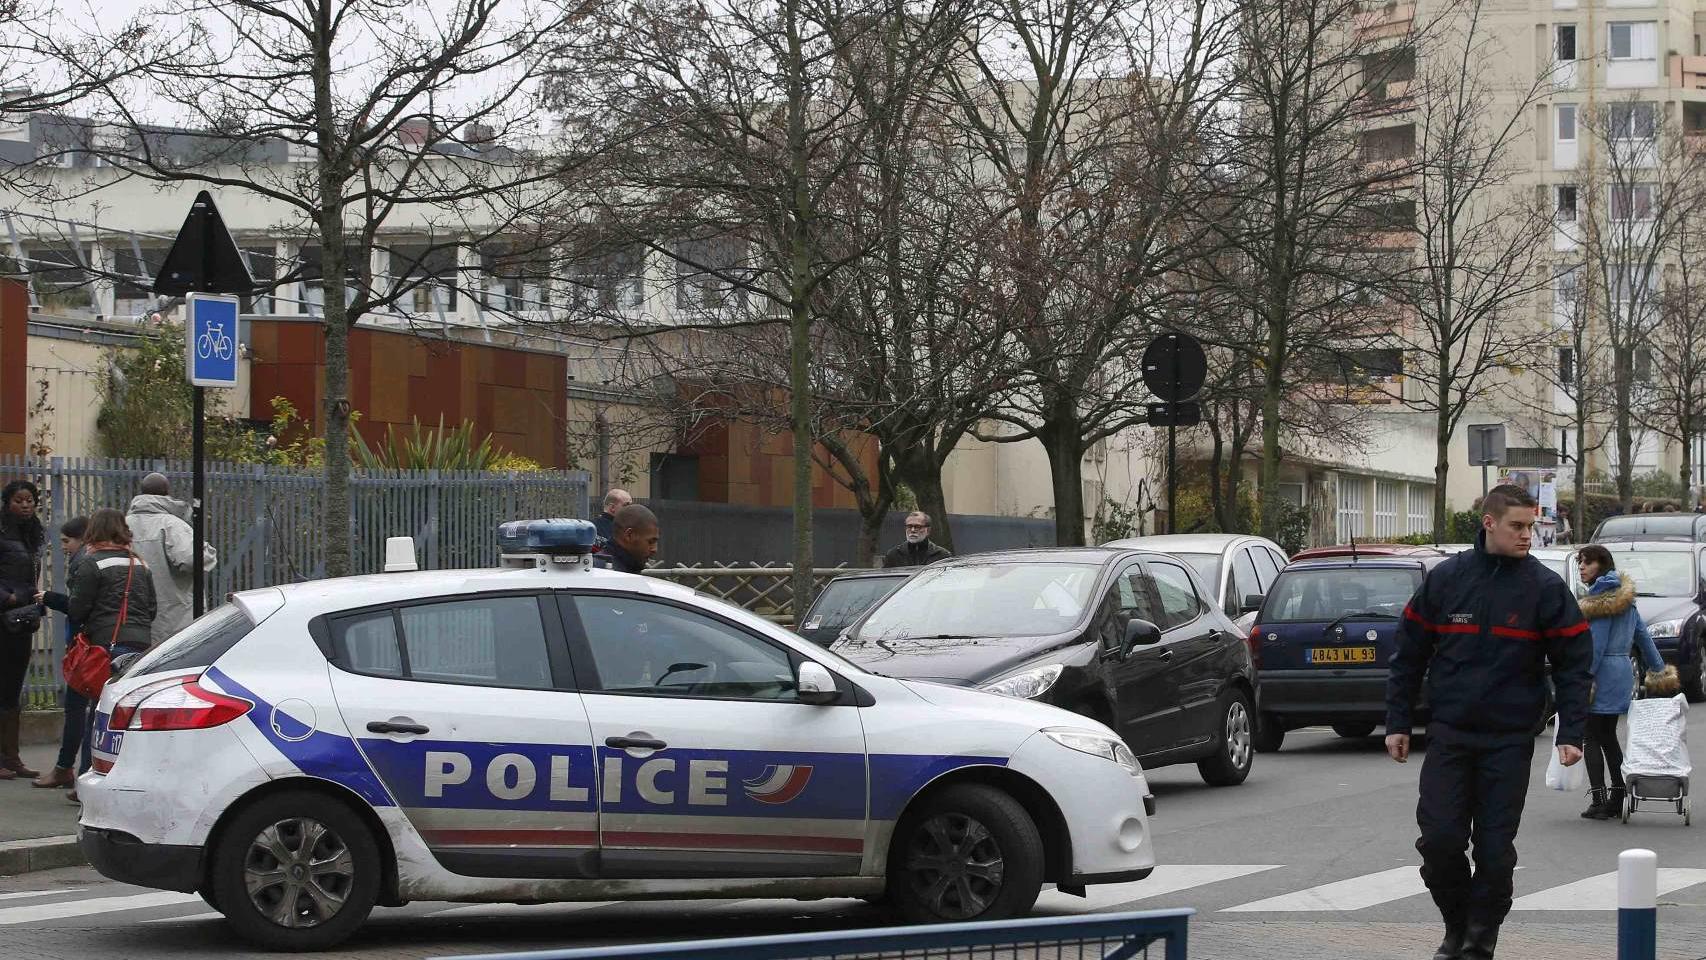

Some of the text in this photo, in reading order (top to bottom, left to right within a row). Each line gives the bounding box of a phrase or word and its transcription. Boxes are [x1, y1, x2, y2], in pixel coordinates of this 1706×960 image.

[1312, 648, 1375, 662] 4843 WL 93
[424, 751, 729, 806] POLICE
